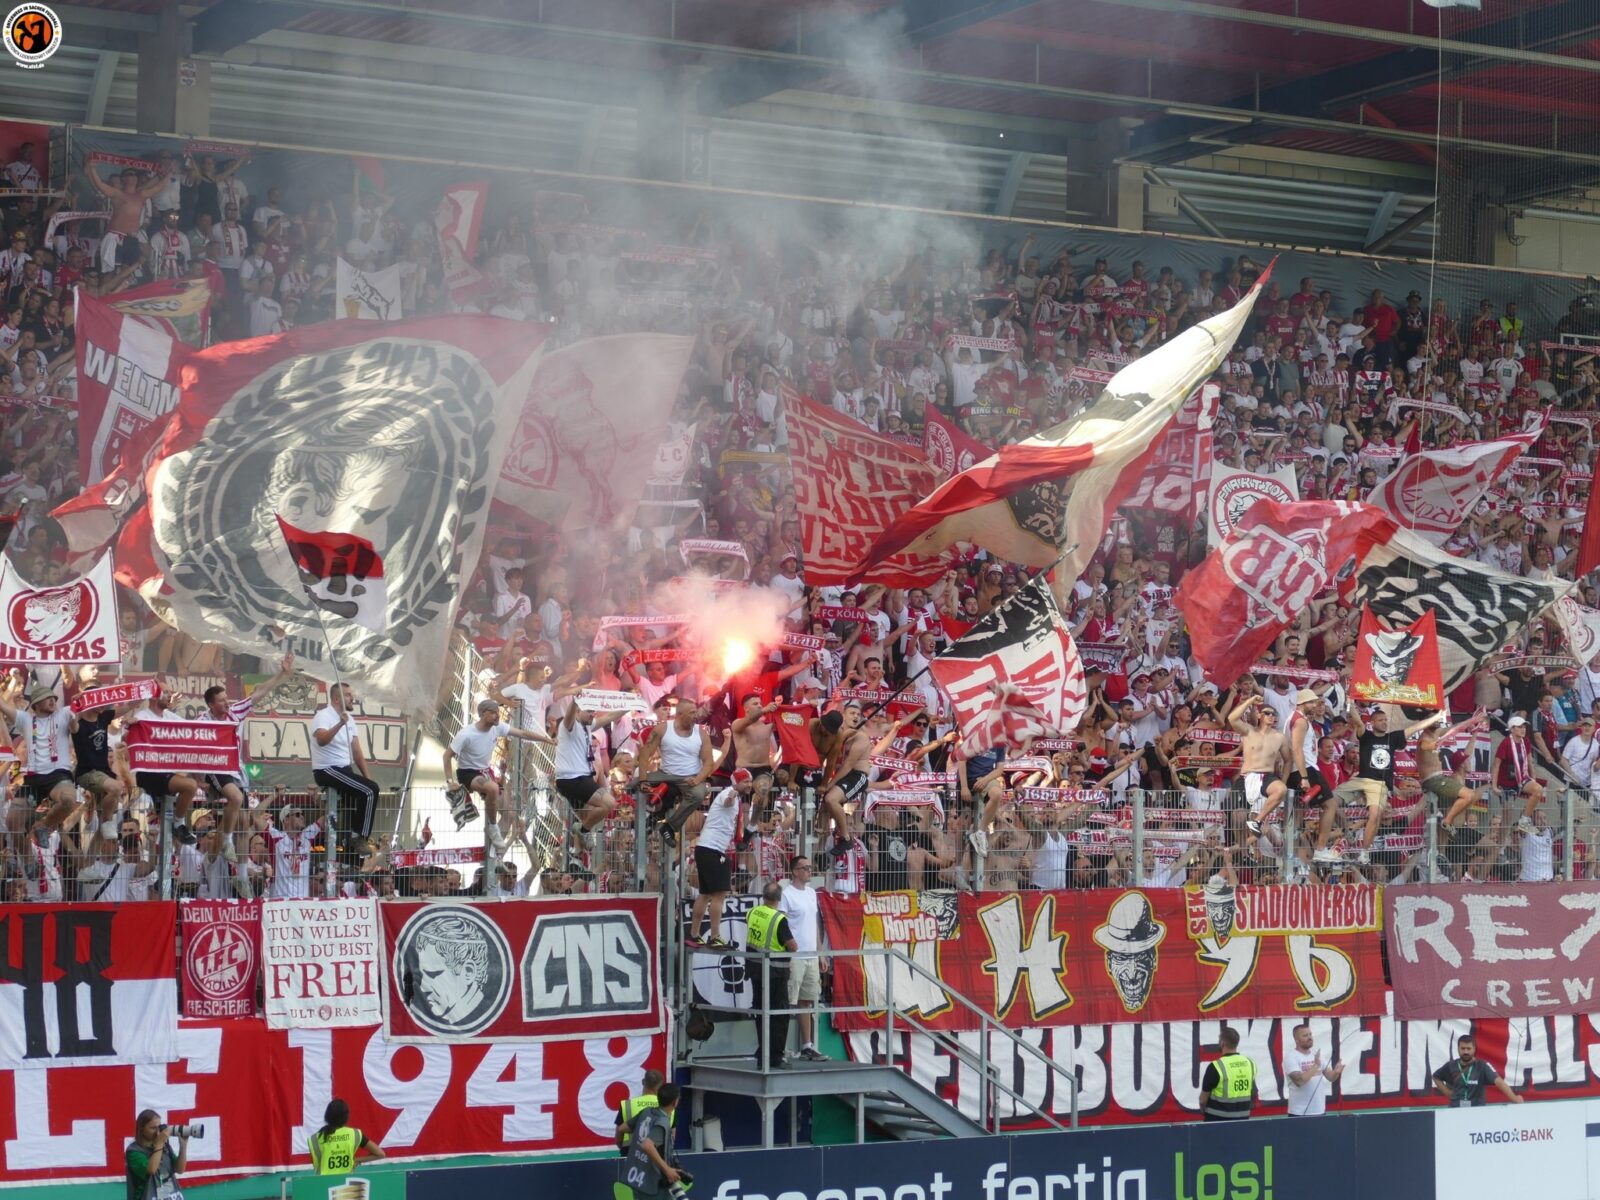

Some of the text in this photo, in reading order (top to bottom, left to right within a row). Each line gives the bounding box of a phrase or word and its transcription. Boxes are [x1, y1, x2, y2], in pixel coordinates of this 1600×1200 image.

[837, 608, 865, 620] KÖLN
[858, 690, 878, 699] SIND
[150, 727, 217, 741] JEMAND SEIN
[184, 904, 259, 923] DEIN WILLE
[268, 906, 371, 923] TU WAS DU
[1235, 884, 1376, 931] STADIONVERBOT
[269, 924, 372, 941] TUN WILLST
[882, 912, 938, 942] Horde
[270, 942, 374, 960] UND DU BIST
[530, 921, 643, 1011] CNS
[270, 960, 376, 999] FREI
[1441, 977, 1594, 1007] CREW
[187, 1000, 251, 1016] GESCHEHE
[288, 1027, 656, 1157] 1948
[1234, 1079, 1249, 1092] 689
[328, 1155, 350, 1170] 638
[627, 1166, 646, 1187] 04
[1175, 1145, 1273, 1200] los!
